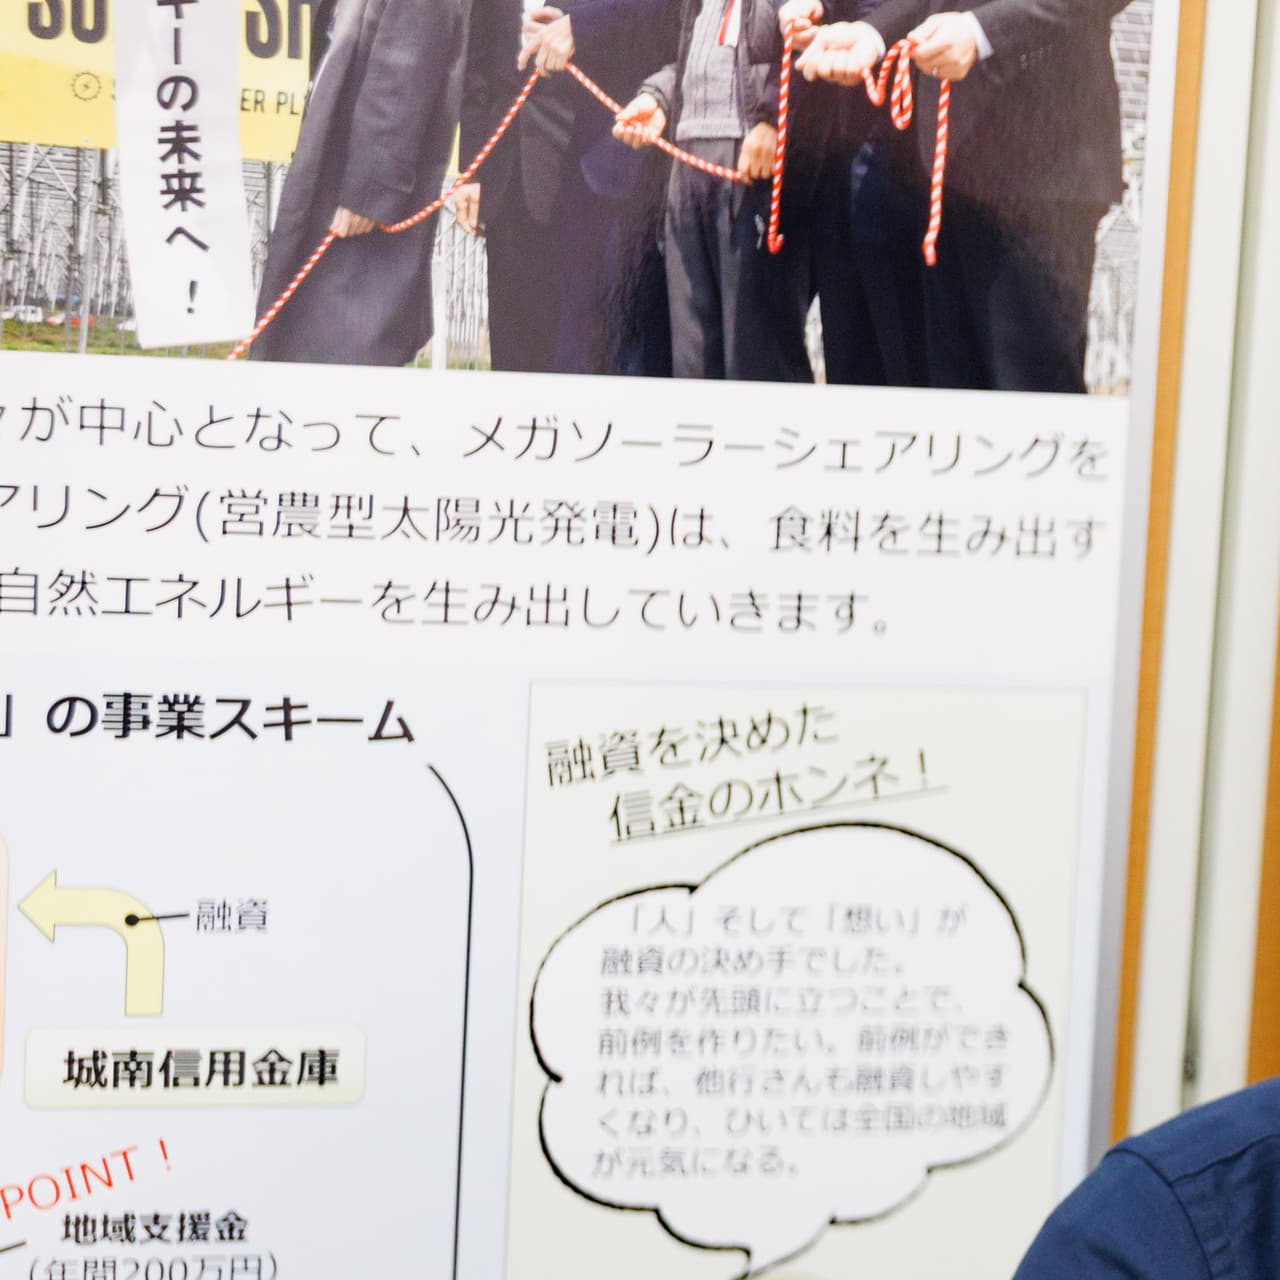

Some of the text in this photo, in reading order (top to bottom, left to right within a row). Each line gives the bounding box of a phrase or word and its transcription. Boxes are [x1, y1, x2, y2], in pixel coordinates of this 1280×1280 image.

[0, 395, 1109, 482] が中心となって、メガソーラーシェアリングを
[0, 566, 890, 637] 自然エネルギーを生み出していきます。
[544, 704, 838, 786] 融資を決めた
[608, 748, 932, 843] 信金のホンネ！
[195, 897, 269, 934] 融資
[62, 1048, 341, 1090] 城南信用金庫
[62, 1211, 249, 1245] 地域支援金
